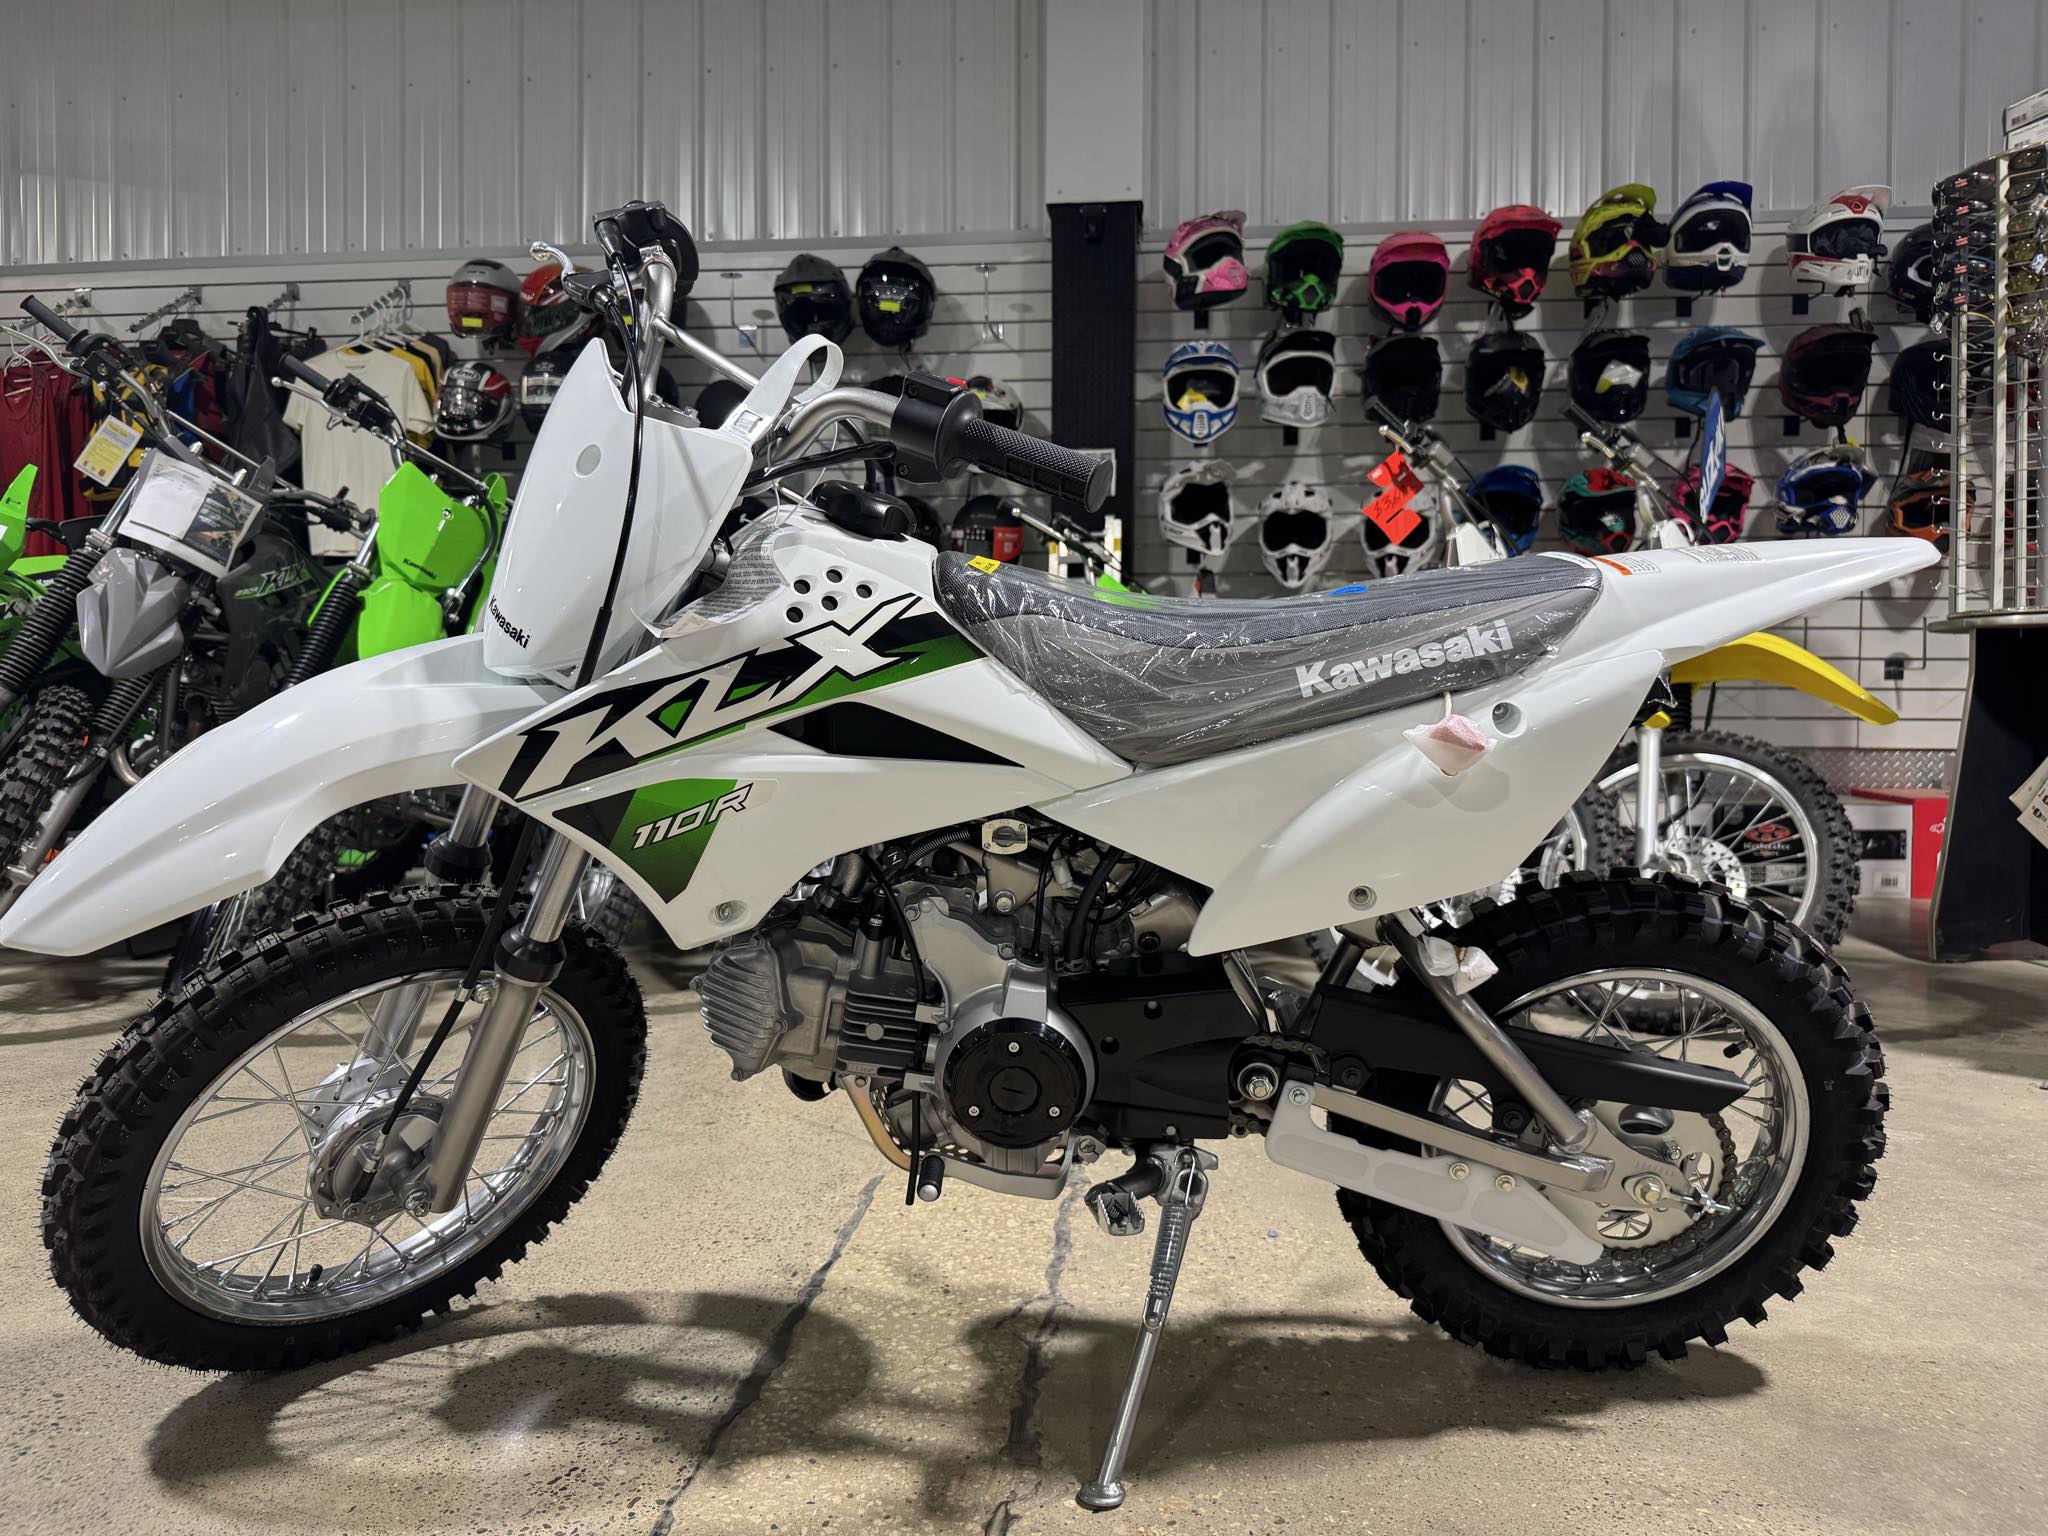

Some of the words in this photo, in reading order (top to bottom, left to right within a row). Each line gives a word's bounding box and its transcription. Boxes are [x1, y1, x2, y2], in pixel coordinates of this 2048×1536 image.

[489, 595, 531, 649] Kawasaki
[1295, 619, 1514, 698] Kawasaki
[498, 593, 930, 802] KLX
[632, 783, 754, 850] 110R
